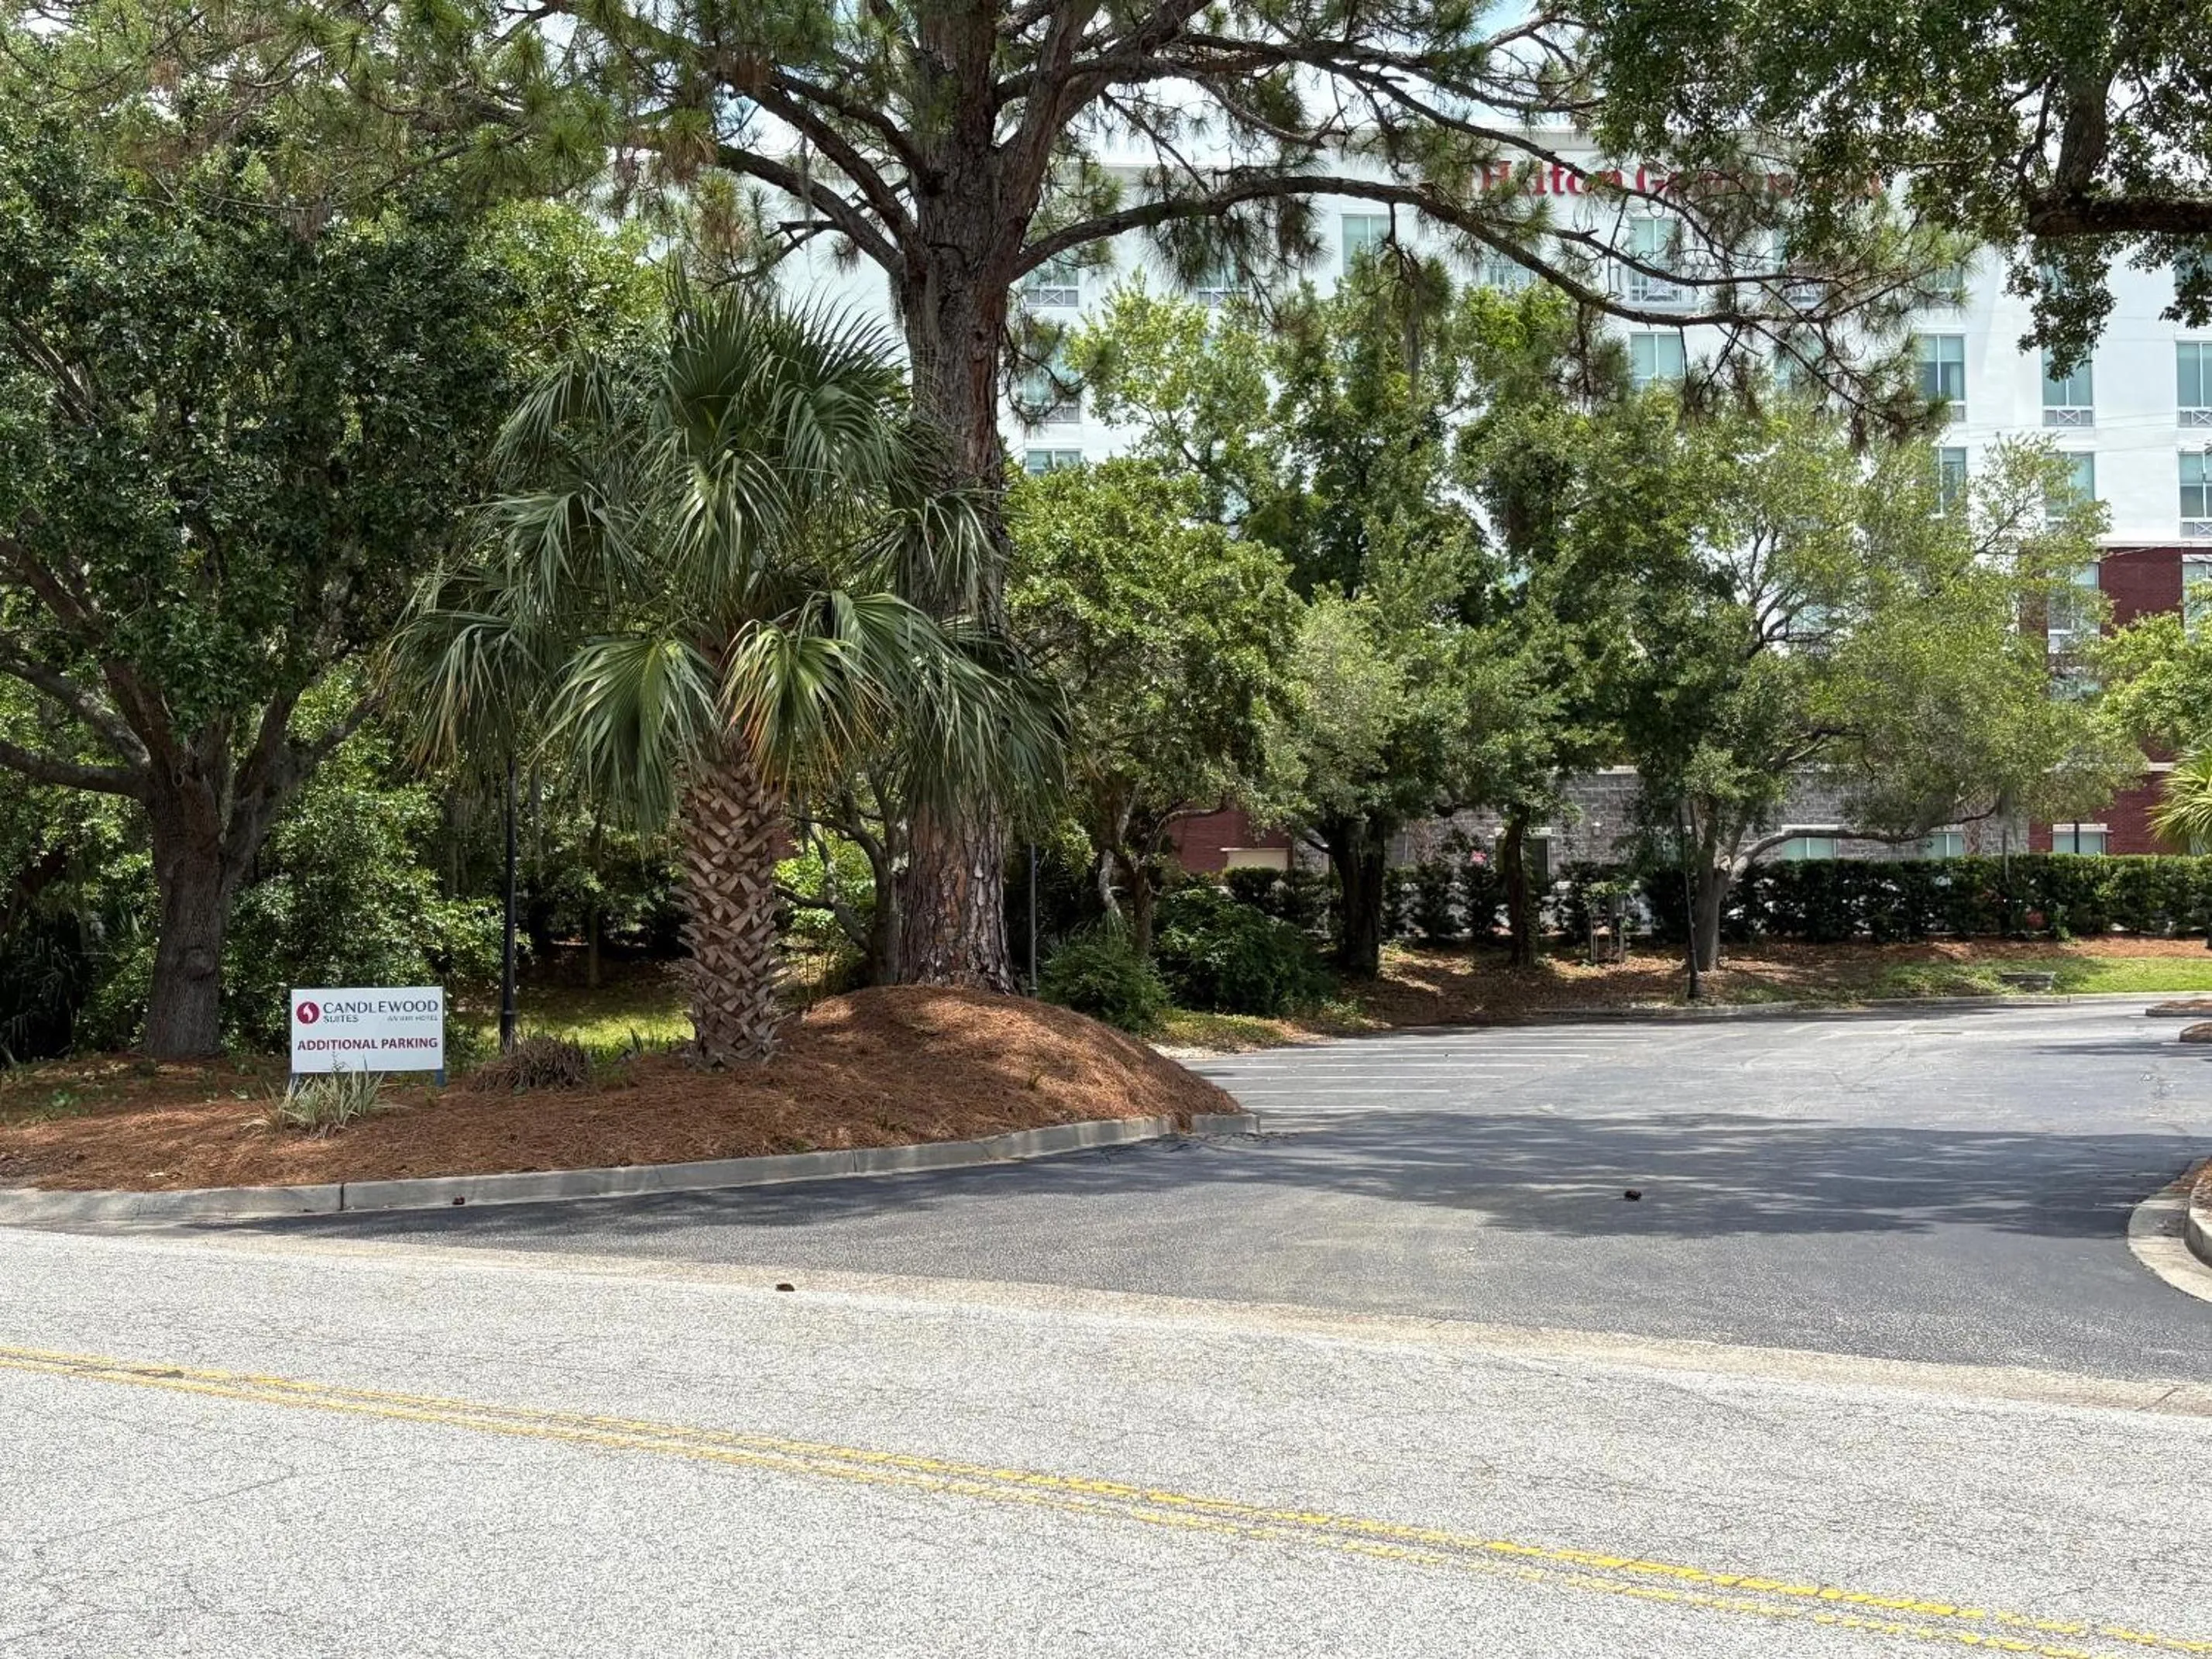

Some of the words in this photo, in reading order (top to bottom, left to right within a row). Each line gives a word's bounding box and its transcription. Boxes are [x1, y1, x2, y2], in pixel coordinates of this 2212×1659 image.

[1478, 160, 1624, 195] Hlton
[323, 1000, 438, 1014] CANDLEWOOD
[323, 1015, 359, 1023] SUITES
[297, 1039, 378, 1050] ADDITIONAL
[381, 1037, 438, 1049] PARKING
